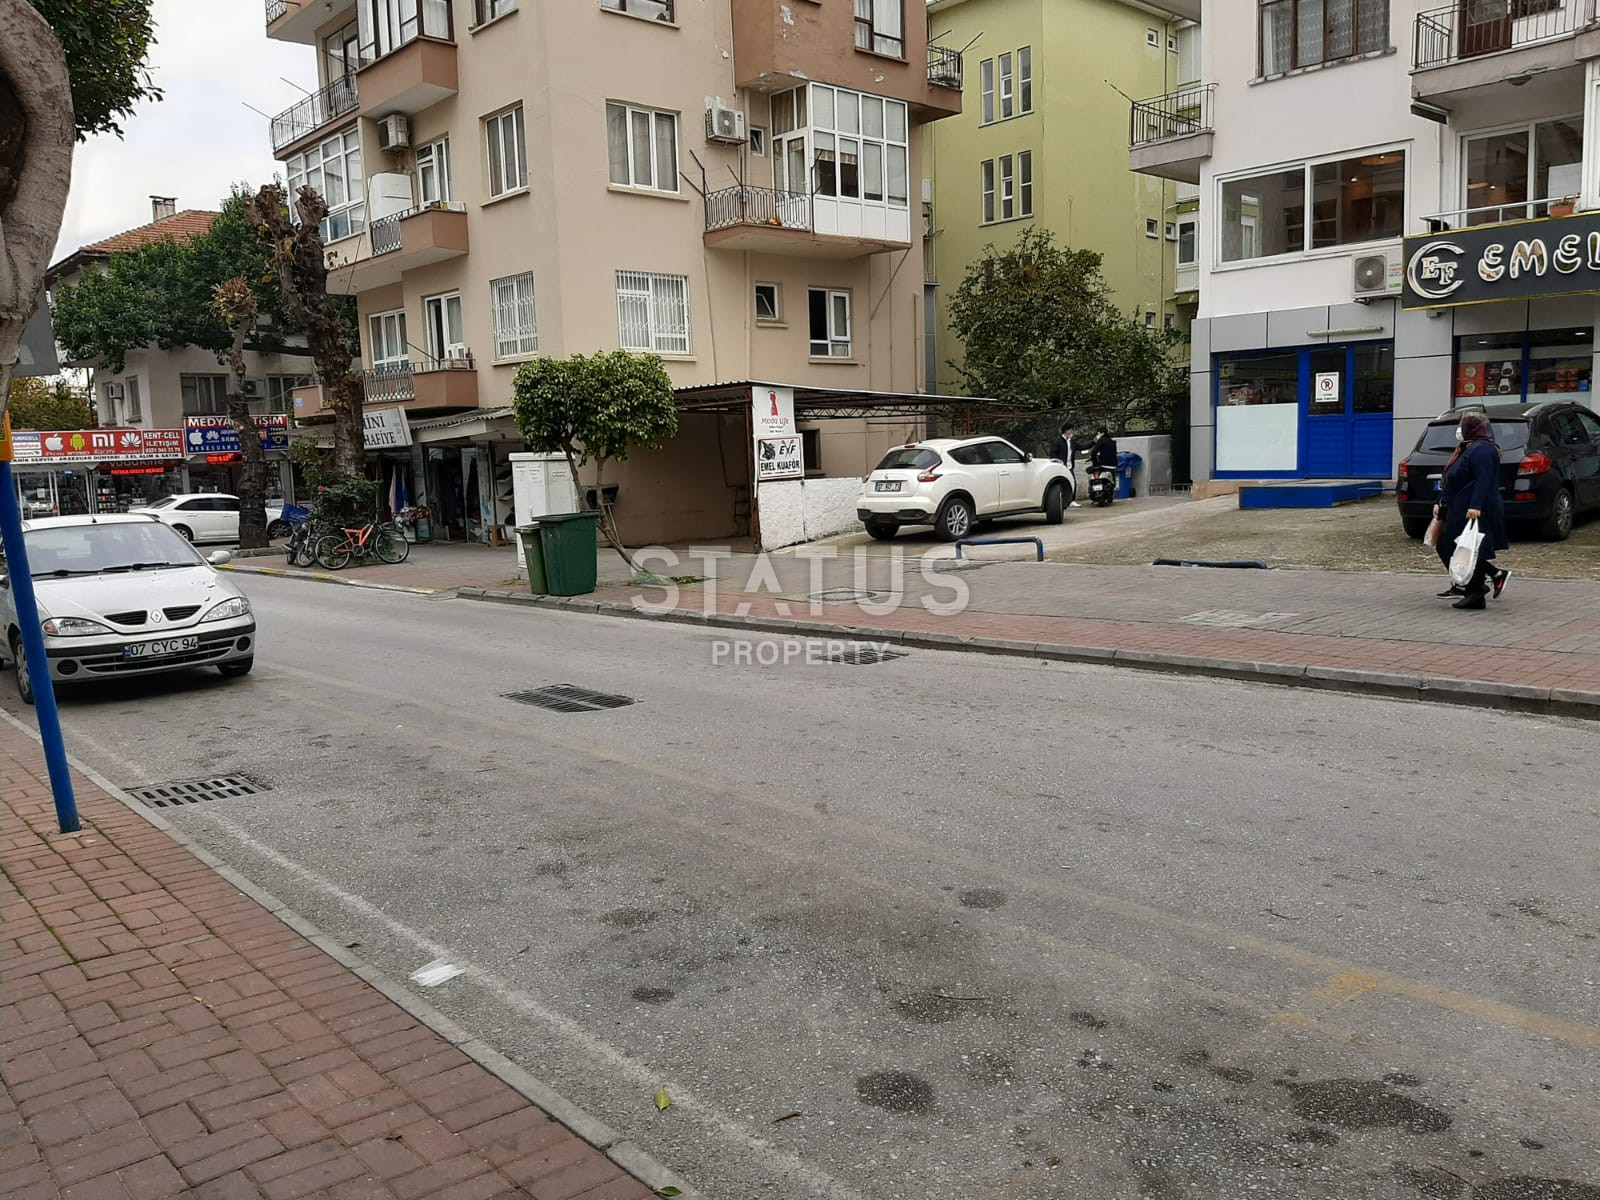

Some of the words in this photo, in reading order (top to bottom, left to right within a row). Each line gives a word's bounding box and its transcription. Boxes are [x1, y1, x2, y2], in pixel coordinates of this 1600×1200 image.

[143, 431, 180, 440] KENT-CELL
[761, 462, 776, 471] EMEL
[131, 644, 146, 656] 07
[152, 640, 179, 654] CYC
[182, 637, 198, 650] 94
